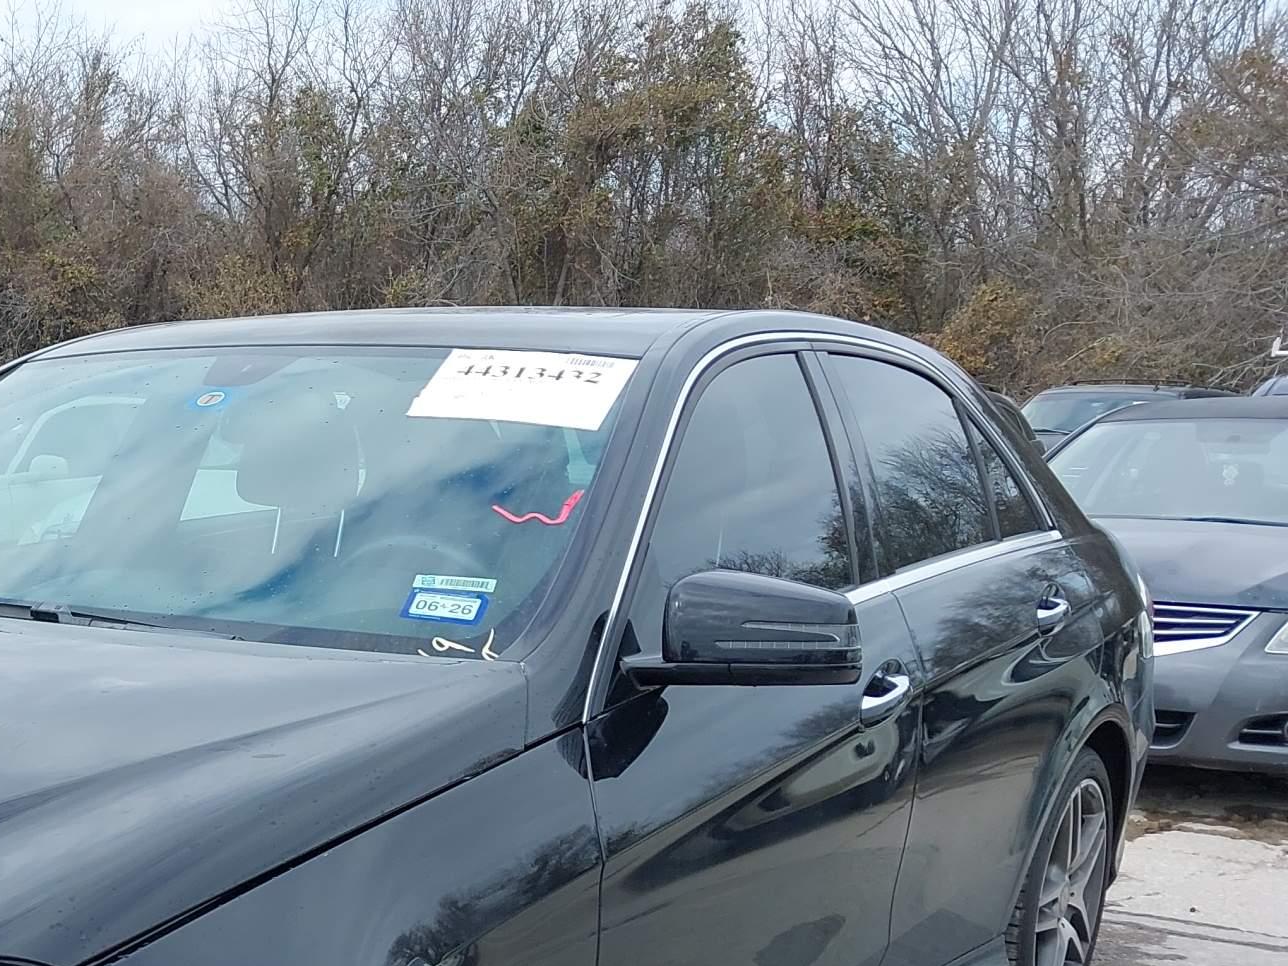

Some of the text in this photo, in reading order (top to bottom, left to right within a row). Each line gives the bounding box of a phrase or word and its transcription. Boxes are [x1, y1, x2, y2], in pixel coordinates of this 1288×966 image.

[457, 365, 602, 384] 44313432
[415, 599, 474, 615] 06 26
